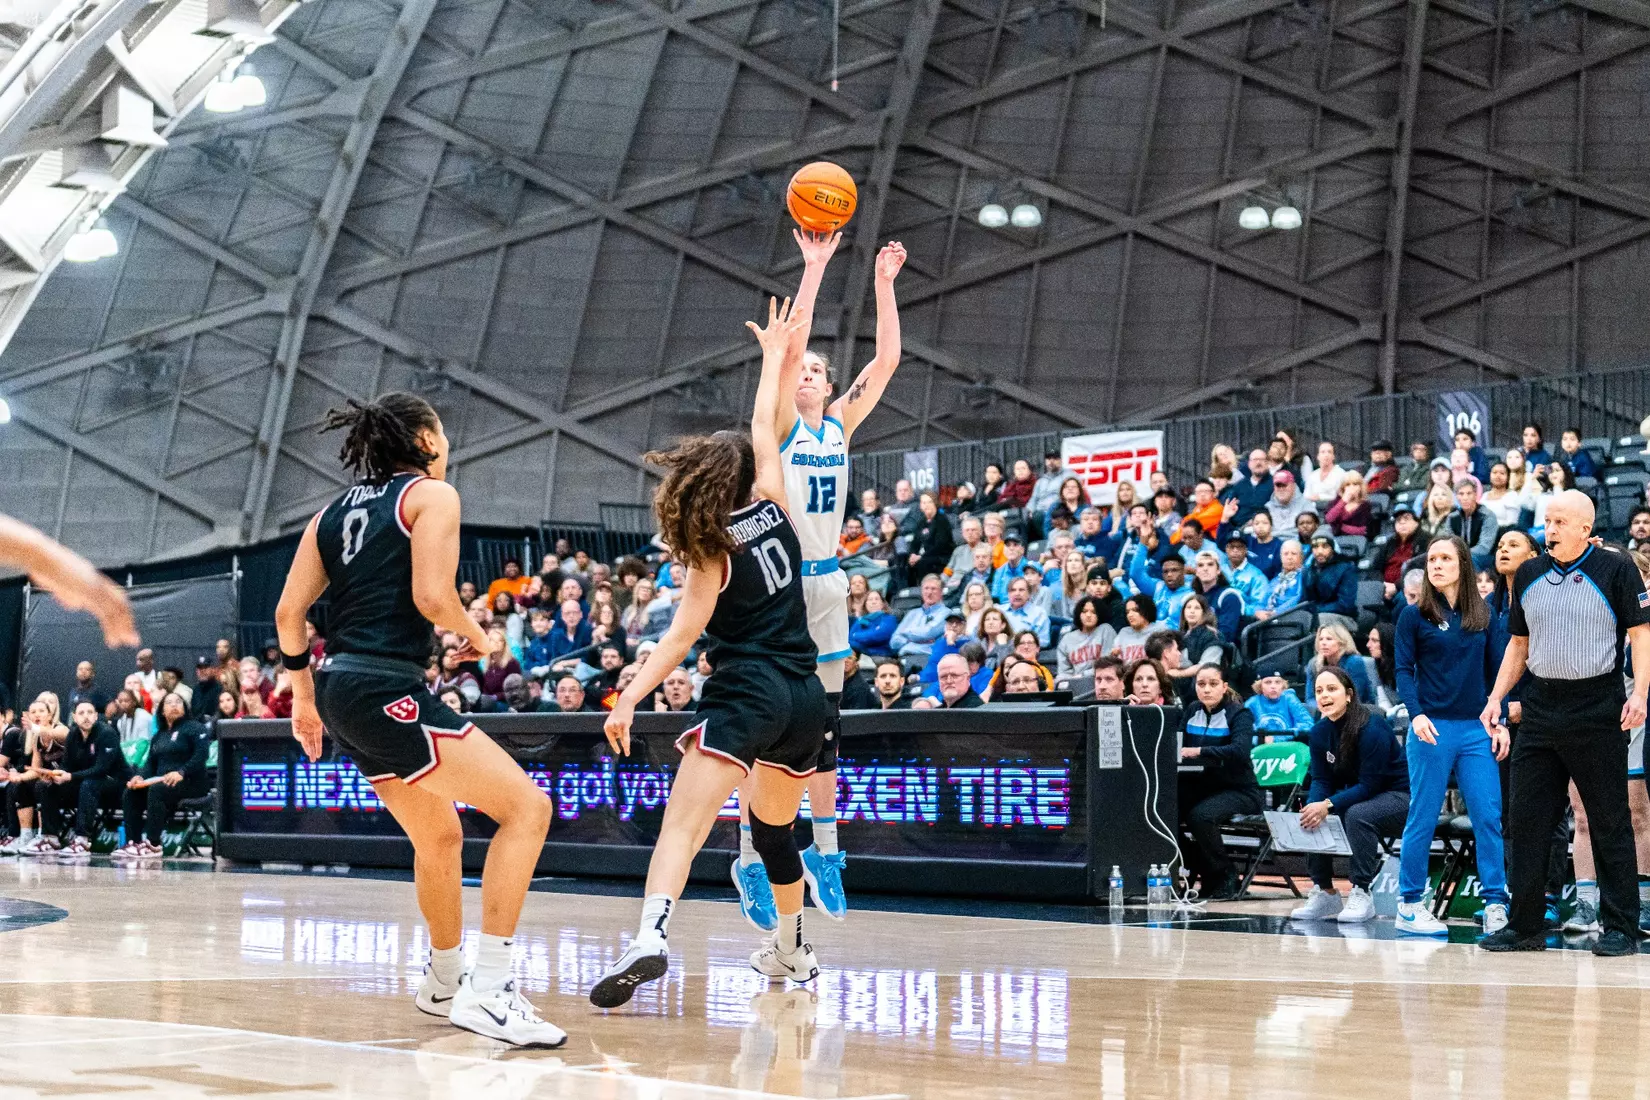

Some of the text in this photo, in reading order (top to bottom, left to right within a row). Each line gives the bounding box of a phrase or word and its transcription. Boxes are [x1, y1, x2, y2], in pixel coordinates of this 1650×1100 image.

[814, 191, 850, 211] ELITE
[1446, 411, 1482, 438] 106
[910, 467, 935, 490] 105
[1069, 447, 1159, 486] ESPN
[806, 474, 837, 514] 12
[343, 507, 368, 565] 0
[751, 537, 793, 596] 10
[810, 562, 817, 575] C
[1250, 754, 1280, 781] vy
[295, 762, 386, 809] NEXE
[558, 755, 616, 820] got
[949, 767, 1070, 824] TIRE
